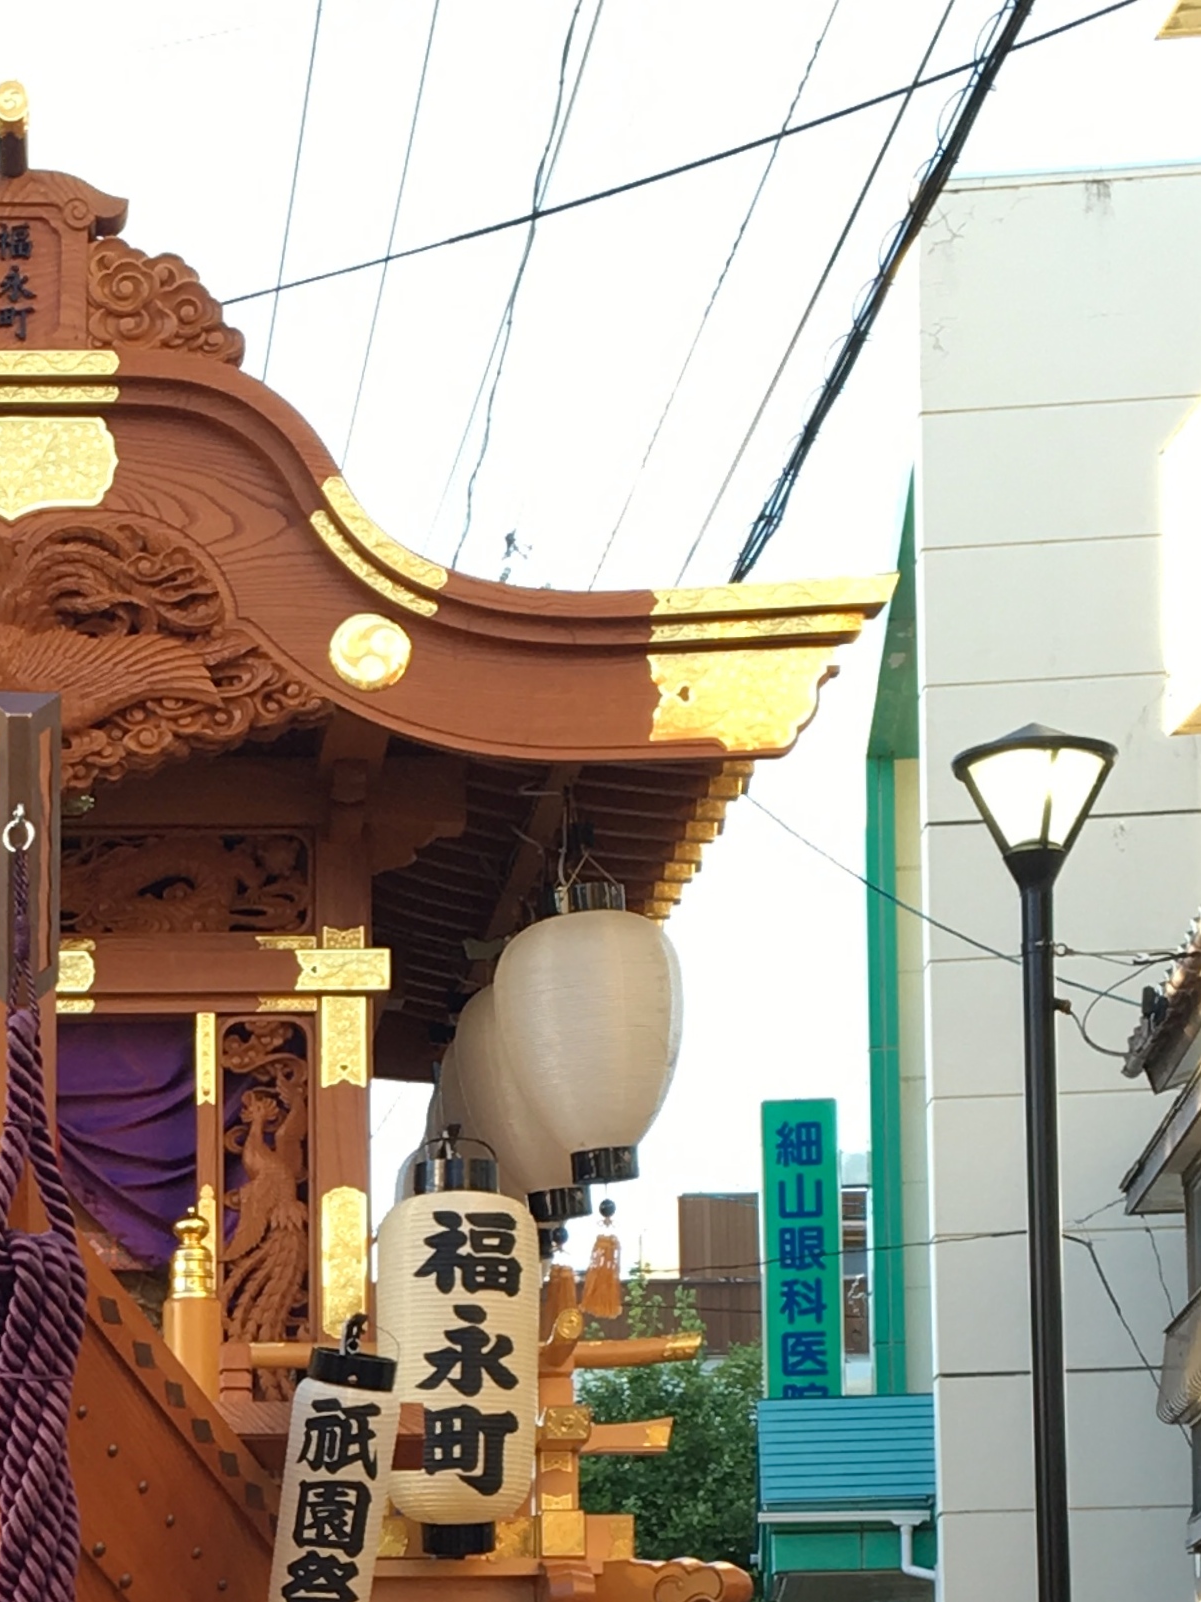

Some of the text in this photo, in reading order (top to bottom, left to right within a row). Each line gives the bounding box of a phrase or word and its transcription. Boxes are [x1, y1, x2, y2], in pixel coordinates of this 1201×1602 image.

[414, 1211, 523, 1496] 福永町
[775, 1121, 829, 1398] 細山眼科医
